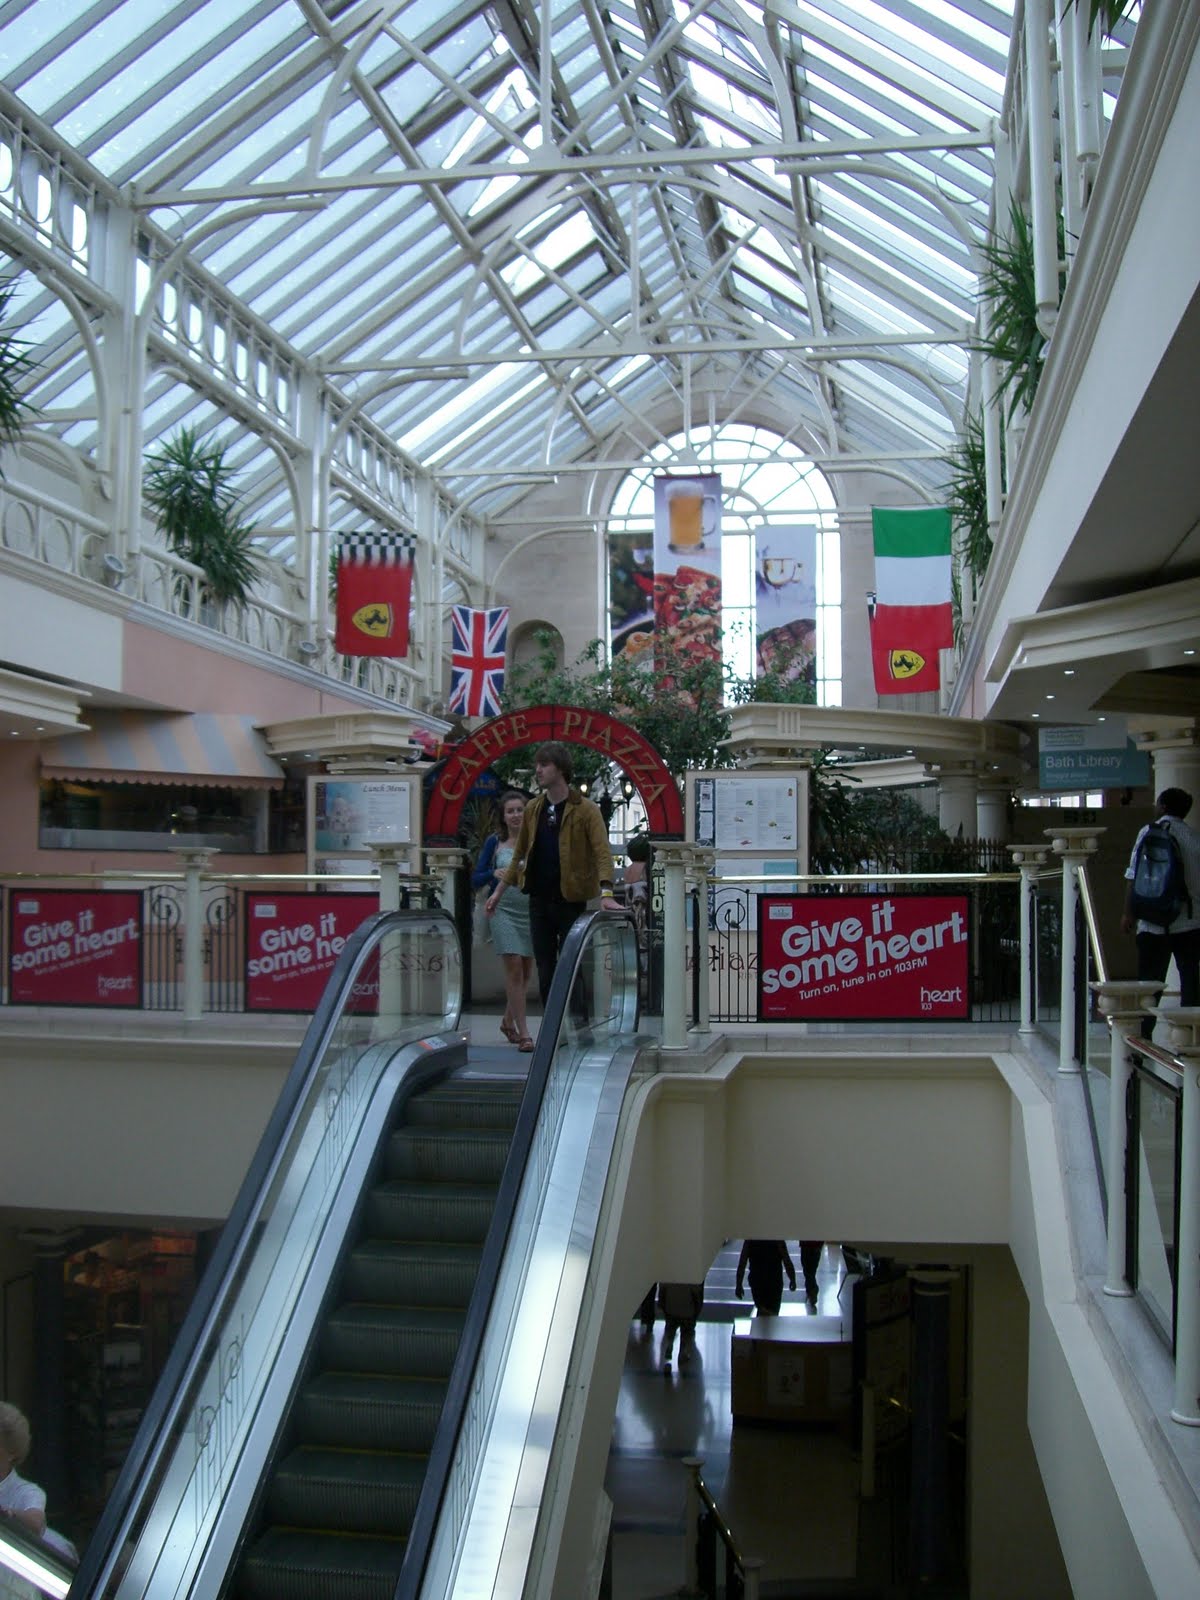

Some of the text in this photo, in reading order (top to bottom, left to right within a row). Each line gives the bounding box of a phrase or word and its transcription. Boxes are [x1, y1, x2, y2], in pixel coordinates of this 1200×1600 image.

[438, 711, 668, 806] CAFFE PIAZZA
[1045, 755, 1122, 769] Bath Library
[24, 909, 95, 947] Give it
[260, 912, 337, 952] Give it
[781, 900, 896, 957] Give it
[12, 941, 71, 972] some
[247, 946, 312, 977] some
[762, 911, 968, 993] some heart.
[98, 974, 133, 990] heart
[799, 988, 821, 1001] Turn
[823, 983, 840, 995] on,
[841, 976, 865, 990] tune
[866, 971, 876, 983] in
[878, 967, 892, 979] on
[920, 986, 962, 1003] heart
[921, 1002, 932, 1011] 103
